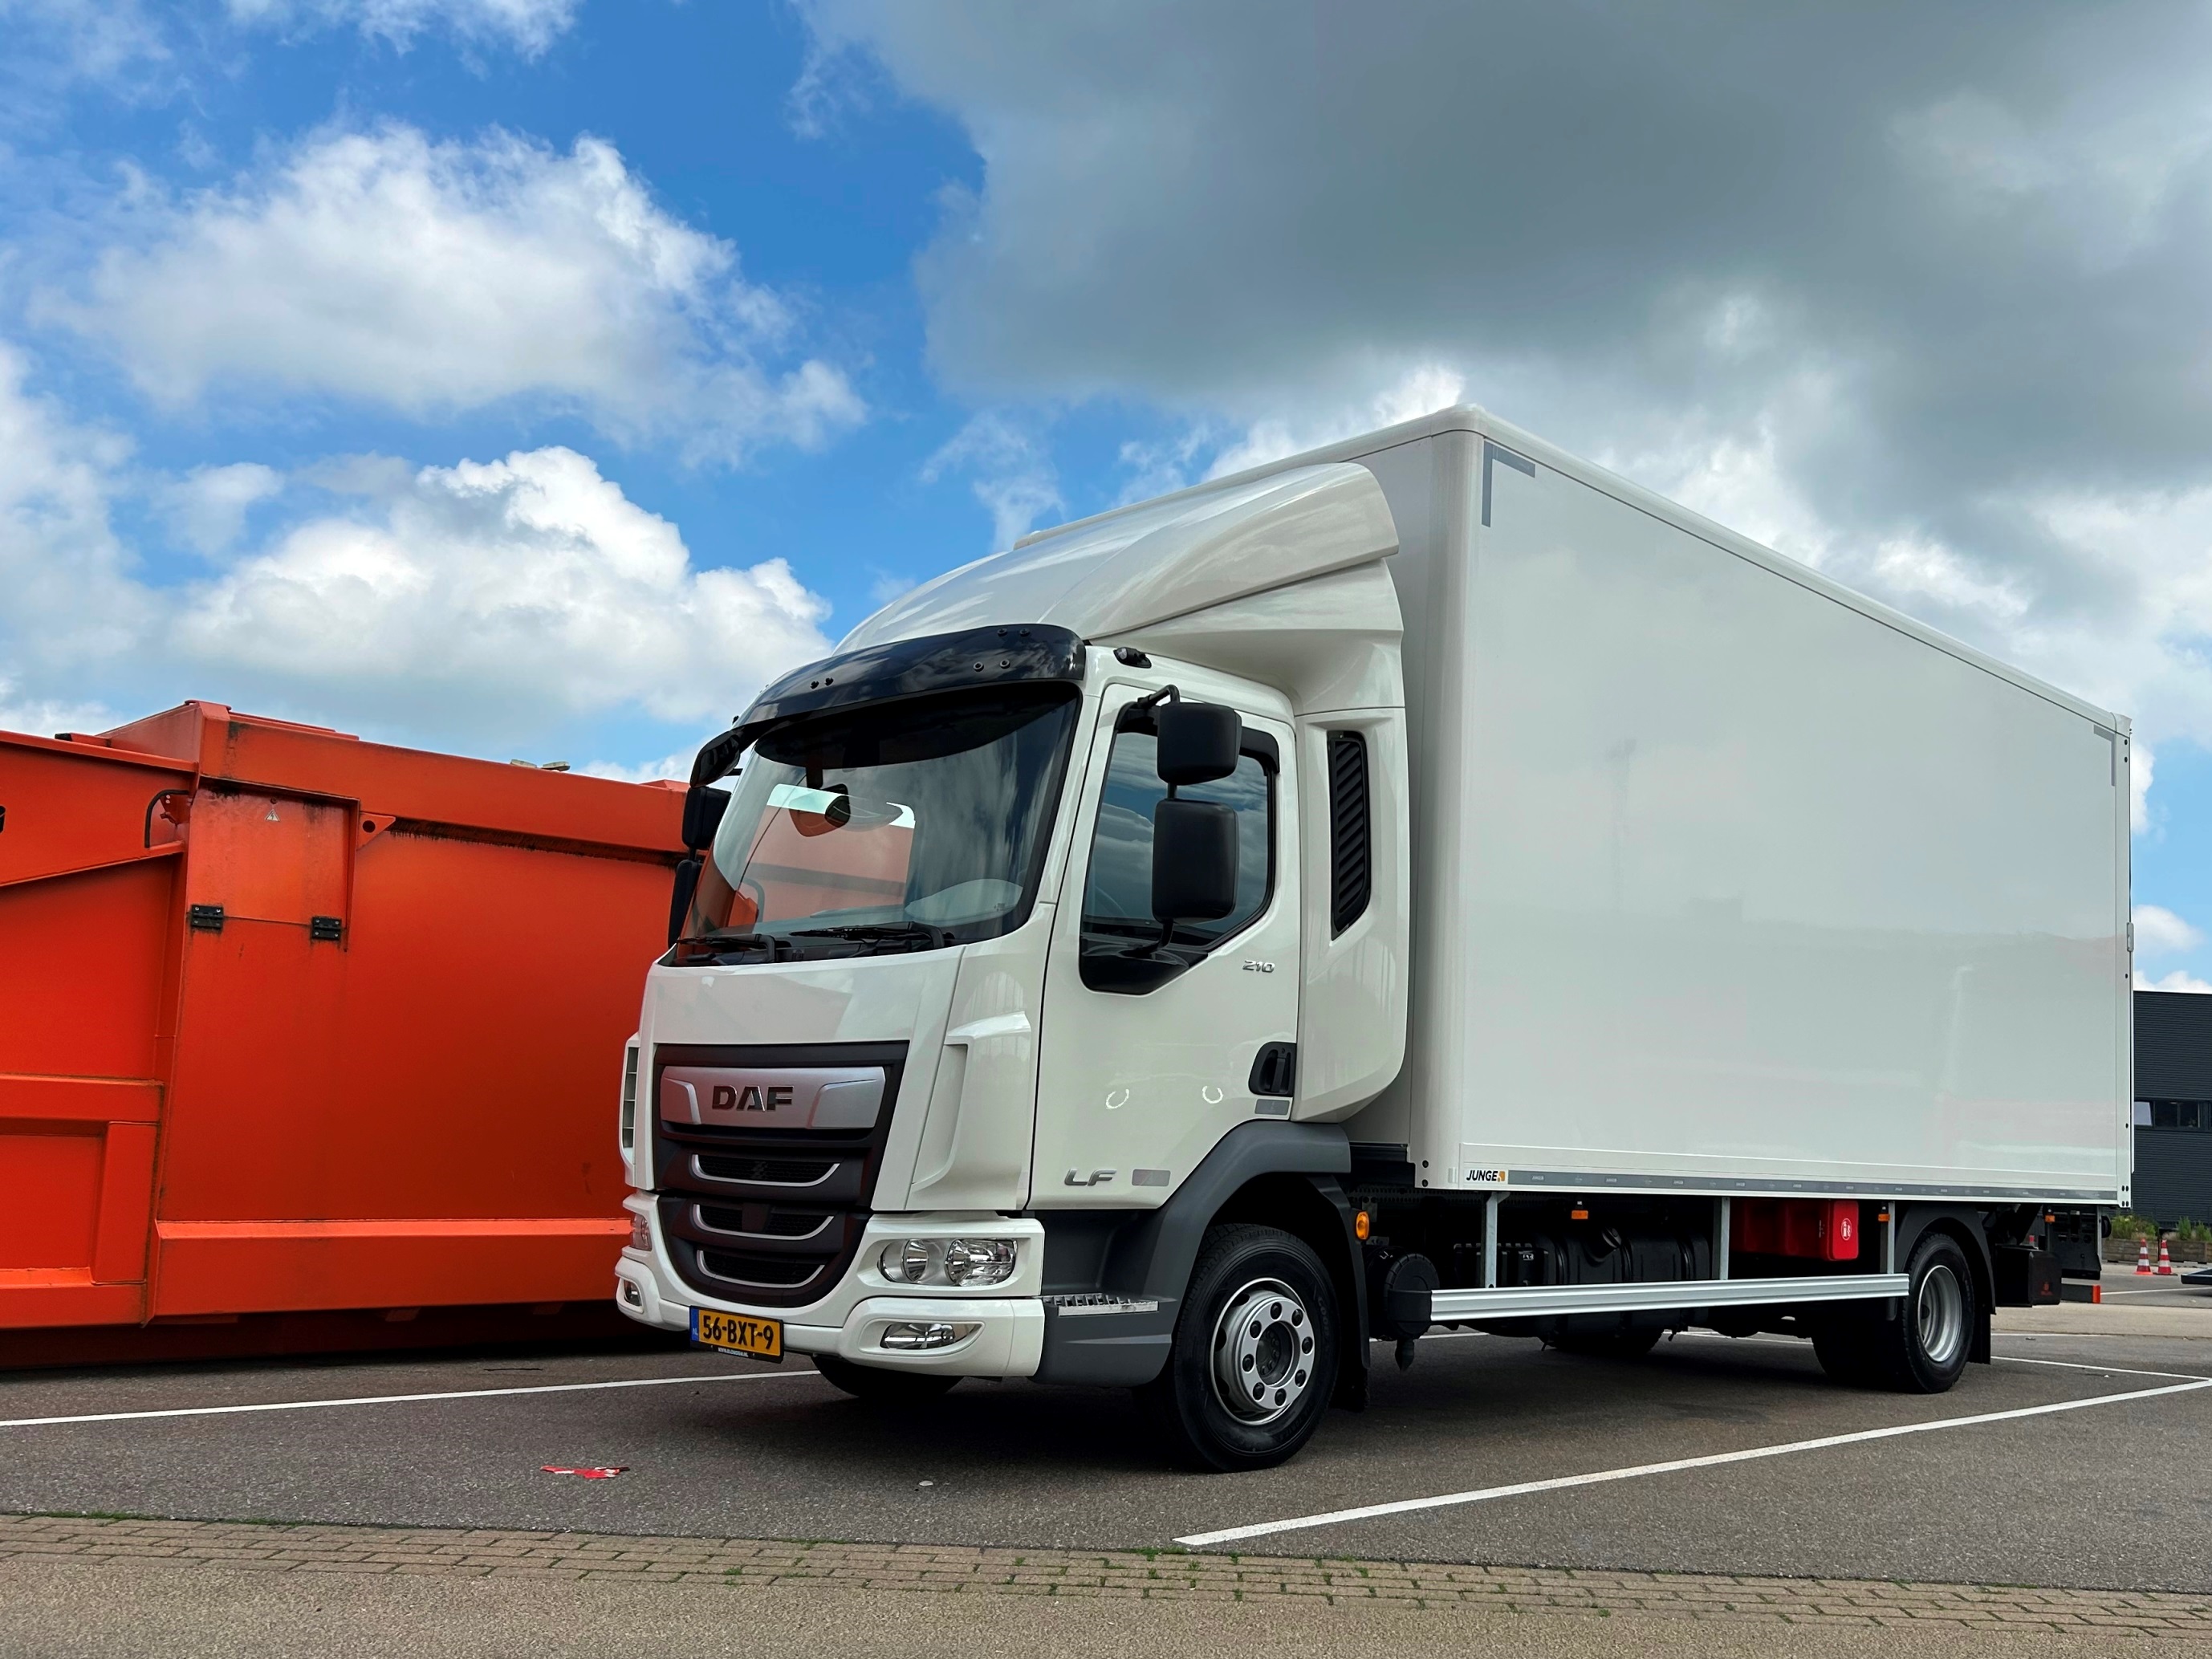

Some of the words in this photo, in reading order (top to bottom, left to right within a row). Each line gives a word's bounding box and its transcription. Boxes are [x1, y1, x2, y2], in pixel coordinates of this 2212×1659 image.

[1242, 959, 1275, 973] 210
[712, 1085, 794, 1111] DAF
[1064, 1169, 1117, 1186] LF
[1466, 1169, 1498, 1182] JUNGE
[692, 1328, 699, 1336] NL
[703, 1315, 774, 1350] 56-BXT-9
